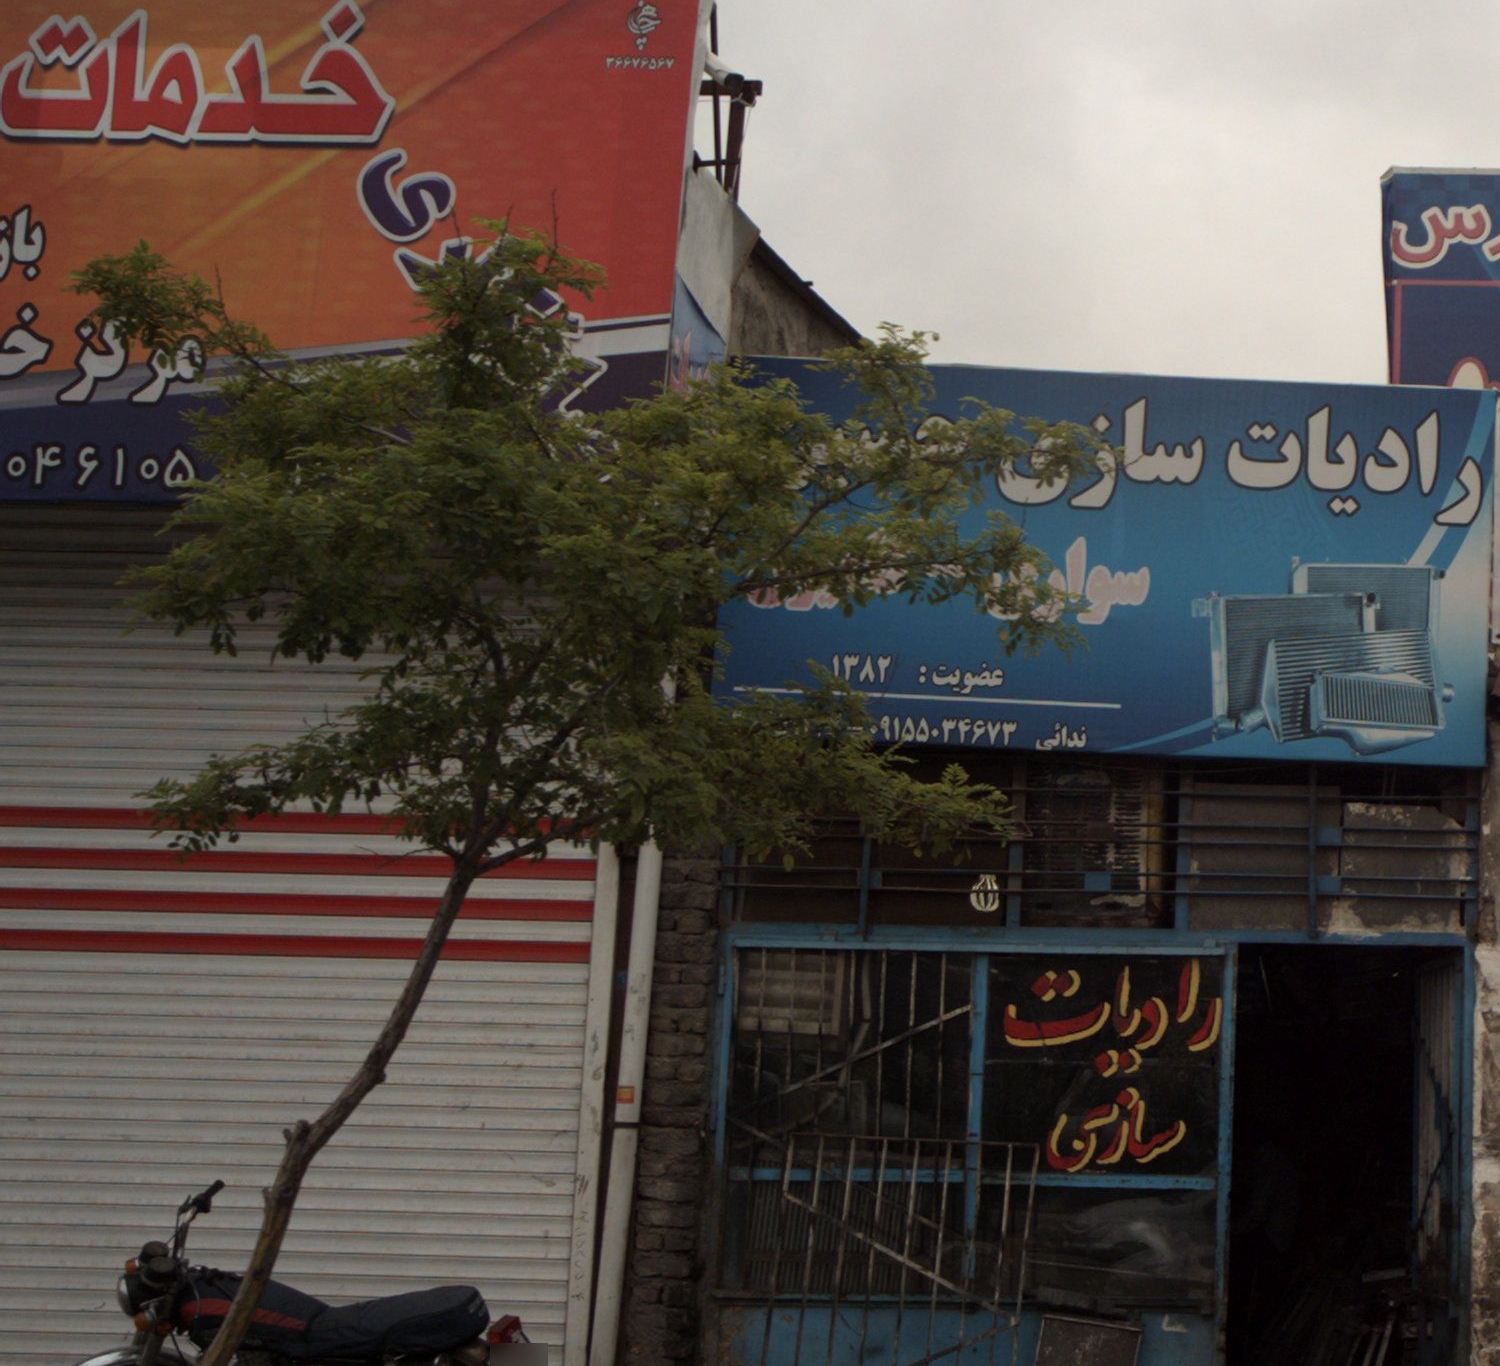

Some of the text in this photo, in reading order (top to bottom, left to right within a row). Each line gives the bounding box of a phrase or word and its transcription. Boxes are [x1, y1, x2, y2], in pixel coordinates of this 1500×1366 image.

[997, 397, 1206, 511] سازی
[1225, 405, 1483, 526] رادیات
[1002, 957, 1223, 1078] رادیات
[1046, 1085, 1187, 1173] سازی
